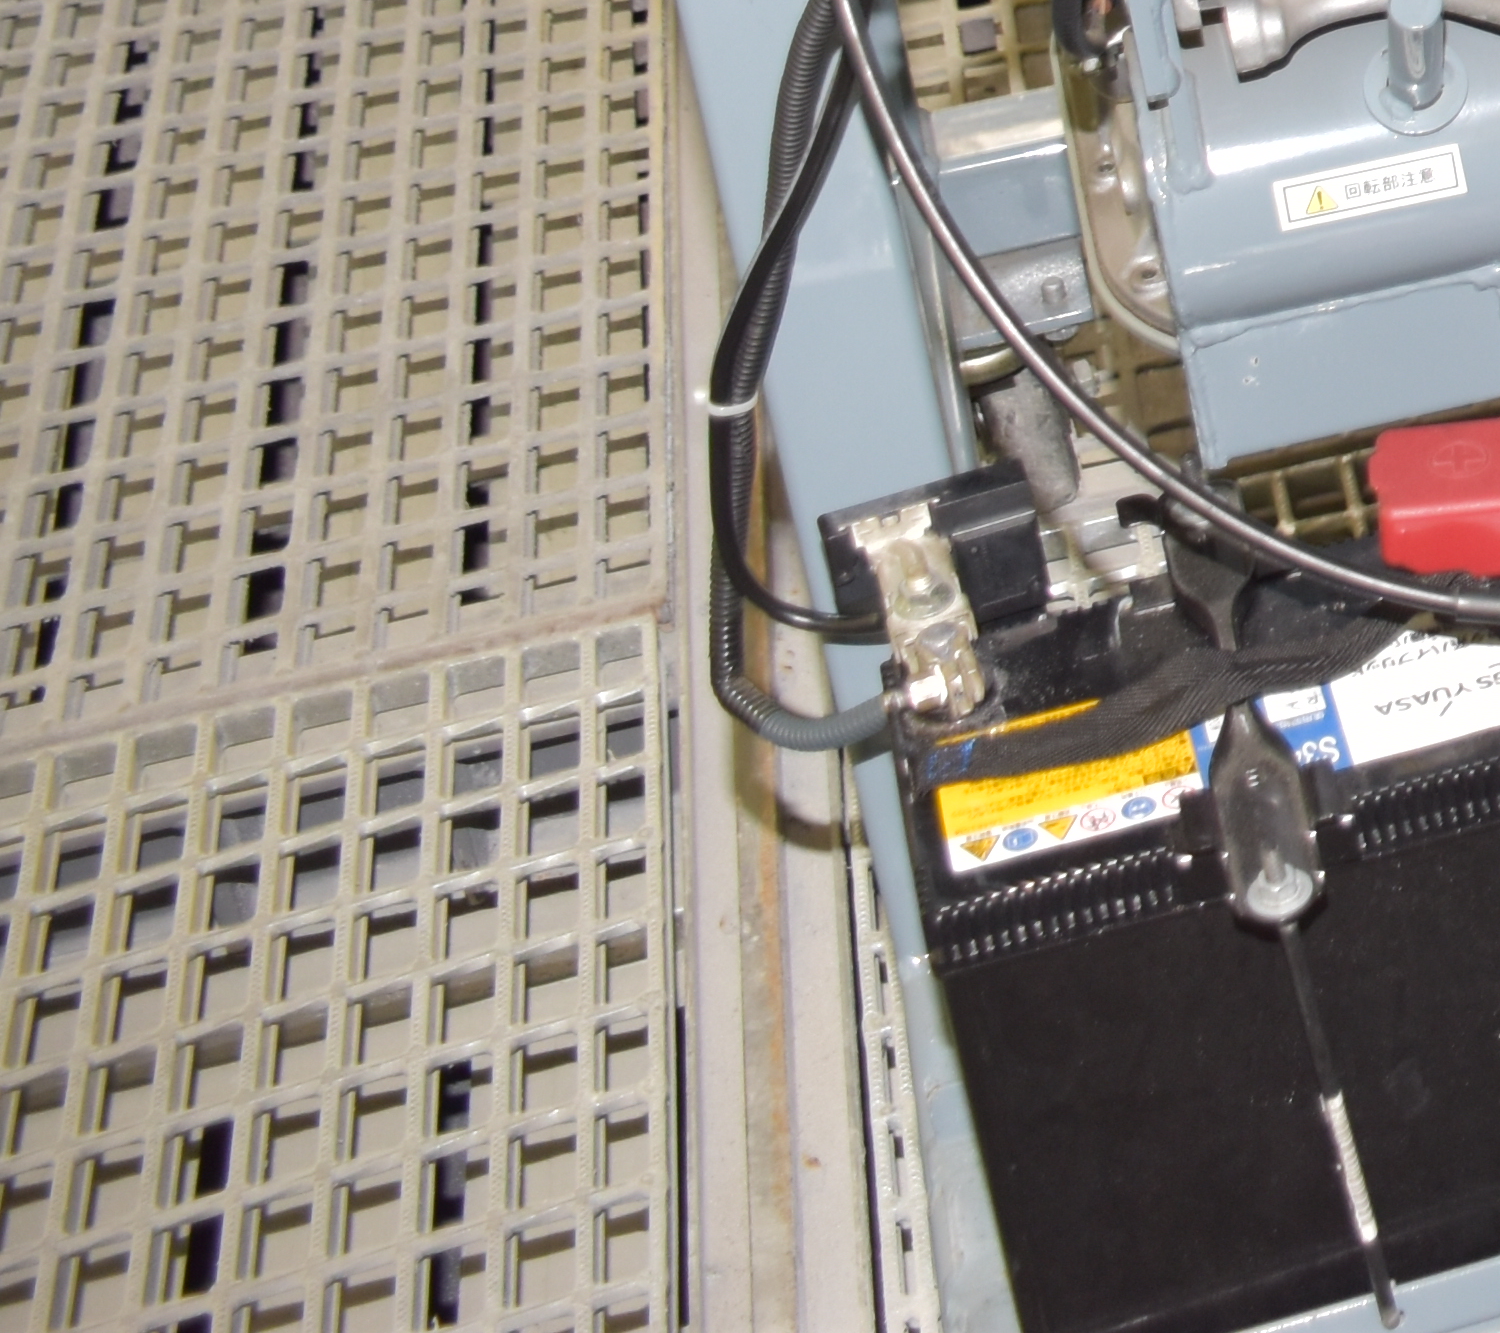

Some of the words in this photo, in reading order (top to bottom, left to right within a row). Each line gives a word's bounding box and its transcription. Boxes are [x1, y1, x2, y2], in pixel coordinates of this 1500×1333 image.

[1345, 166, 1437, 200] 回転部注意
[1373, 681, 1469, 717] YUASA
